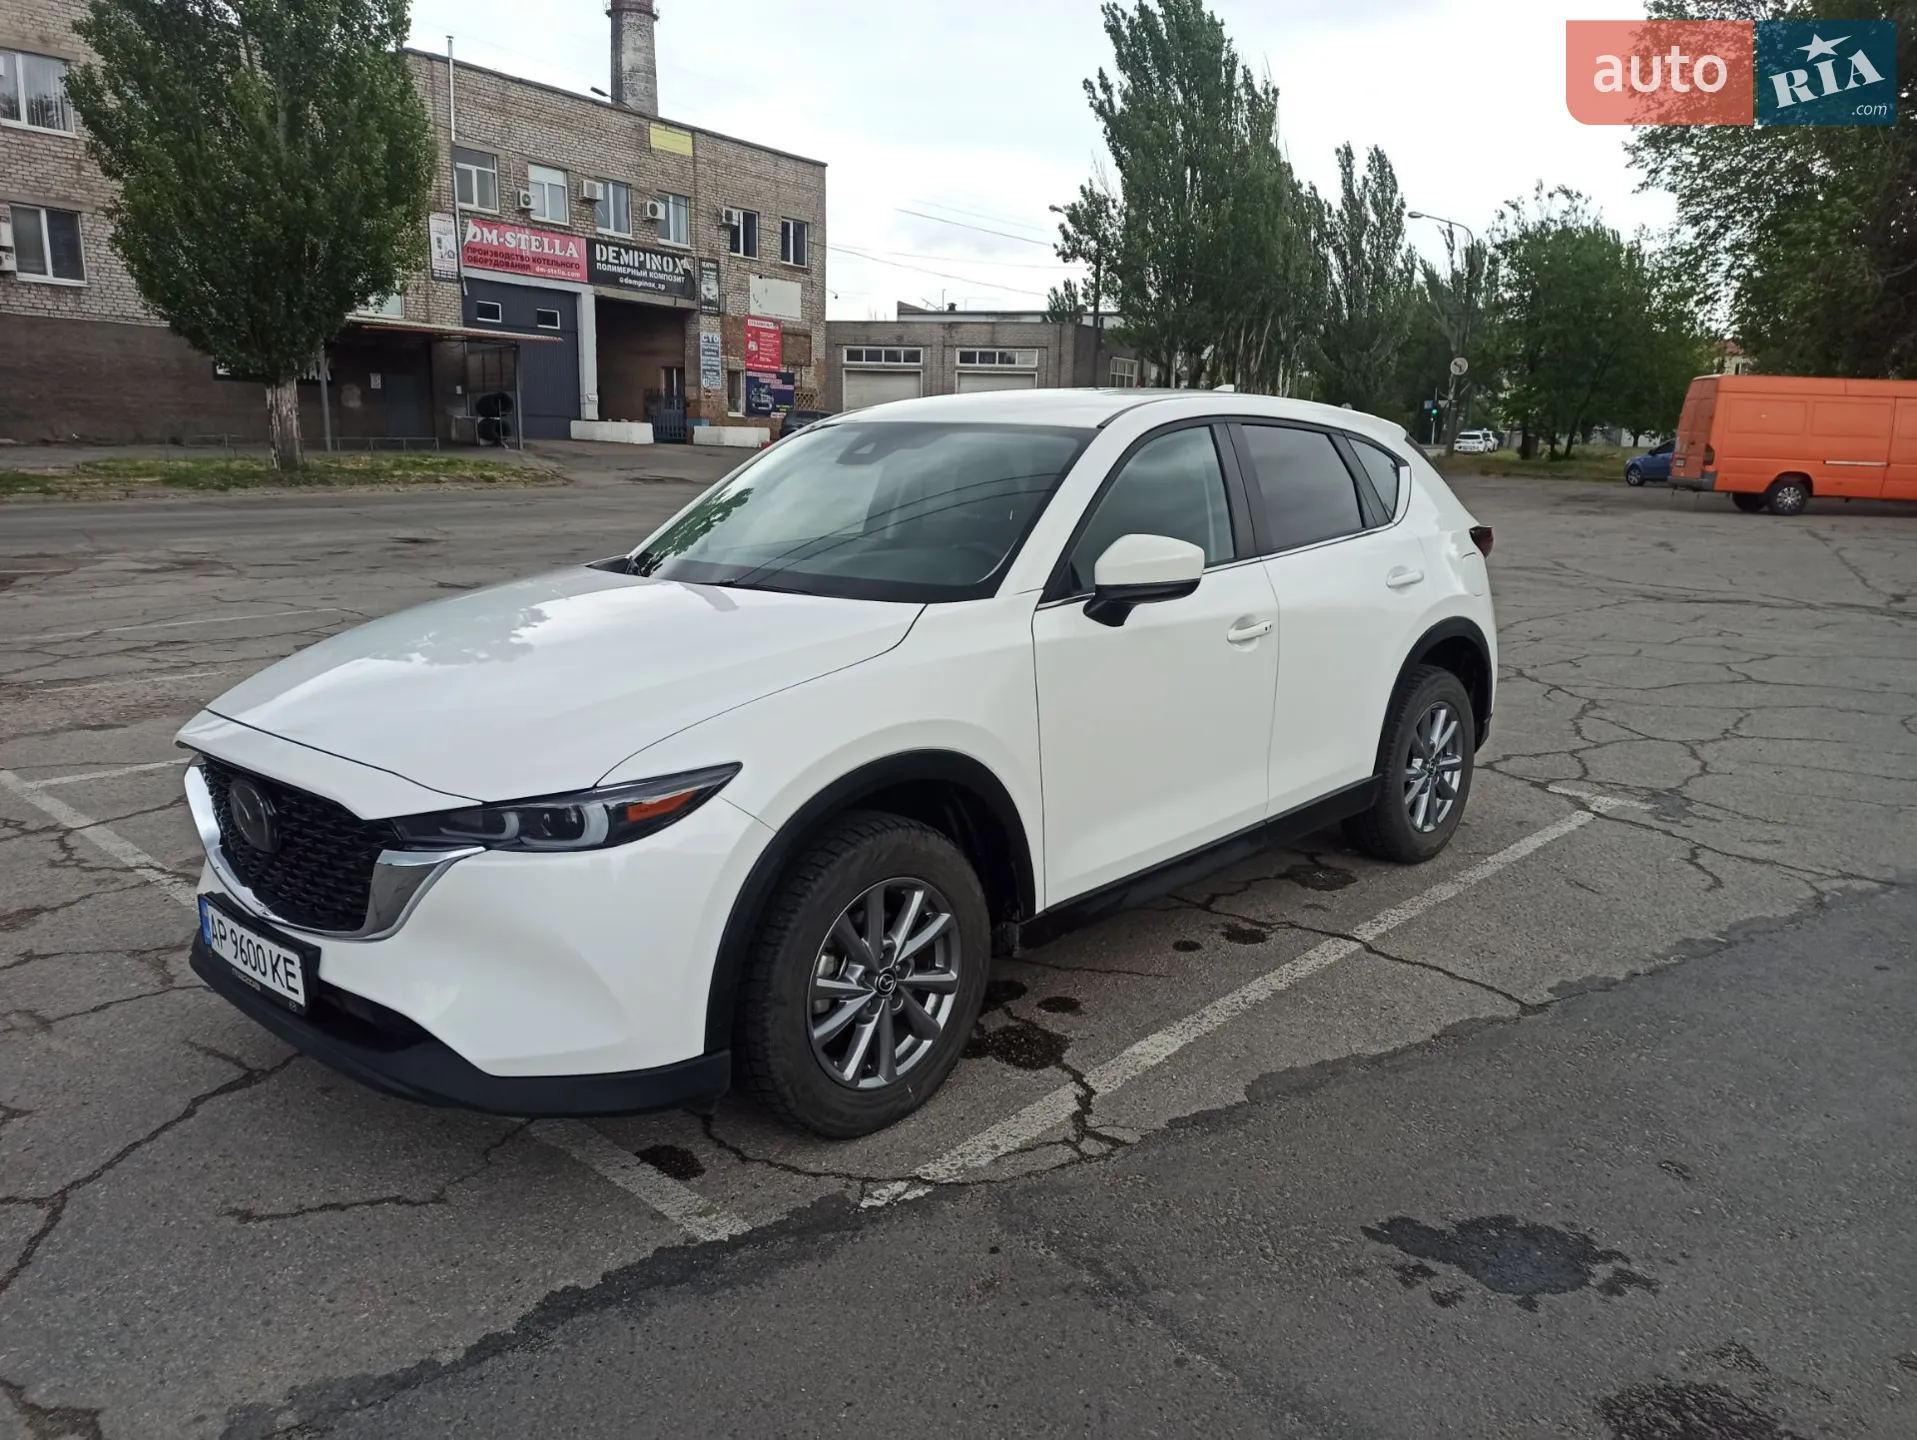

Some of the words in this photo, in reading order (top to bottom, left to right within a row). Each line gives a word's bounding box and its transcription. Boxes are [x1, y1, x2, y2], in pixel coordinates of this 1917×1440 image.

[464, 219, 579, 258] DM-STELLA
[467, 246, 530, 262] ПРОИЗВОДСТВО
[532, 256, 580, 270] КОТЕЛЬНОГО
[467, 255, 531, 271] ОБОРУДОВАНИЯ
[595, 243, 684, 275] DEMPINOX
[535, 266, 581, 277] dm-stella.com
[596, 262, 648, 277] ПОЛИМЕРНЫЙ
[649, 271, 685, 283] КОМПОЗИТ
[211, 914, 227, 949] AP
[230, 928, 267, 977] 9600
[269, 949, 299, 995] KE
